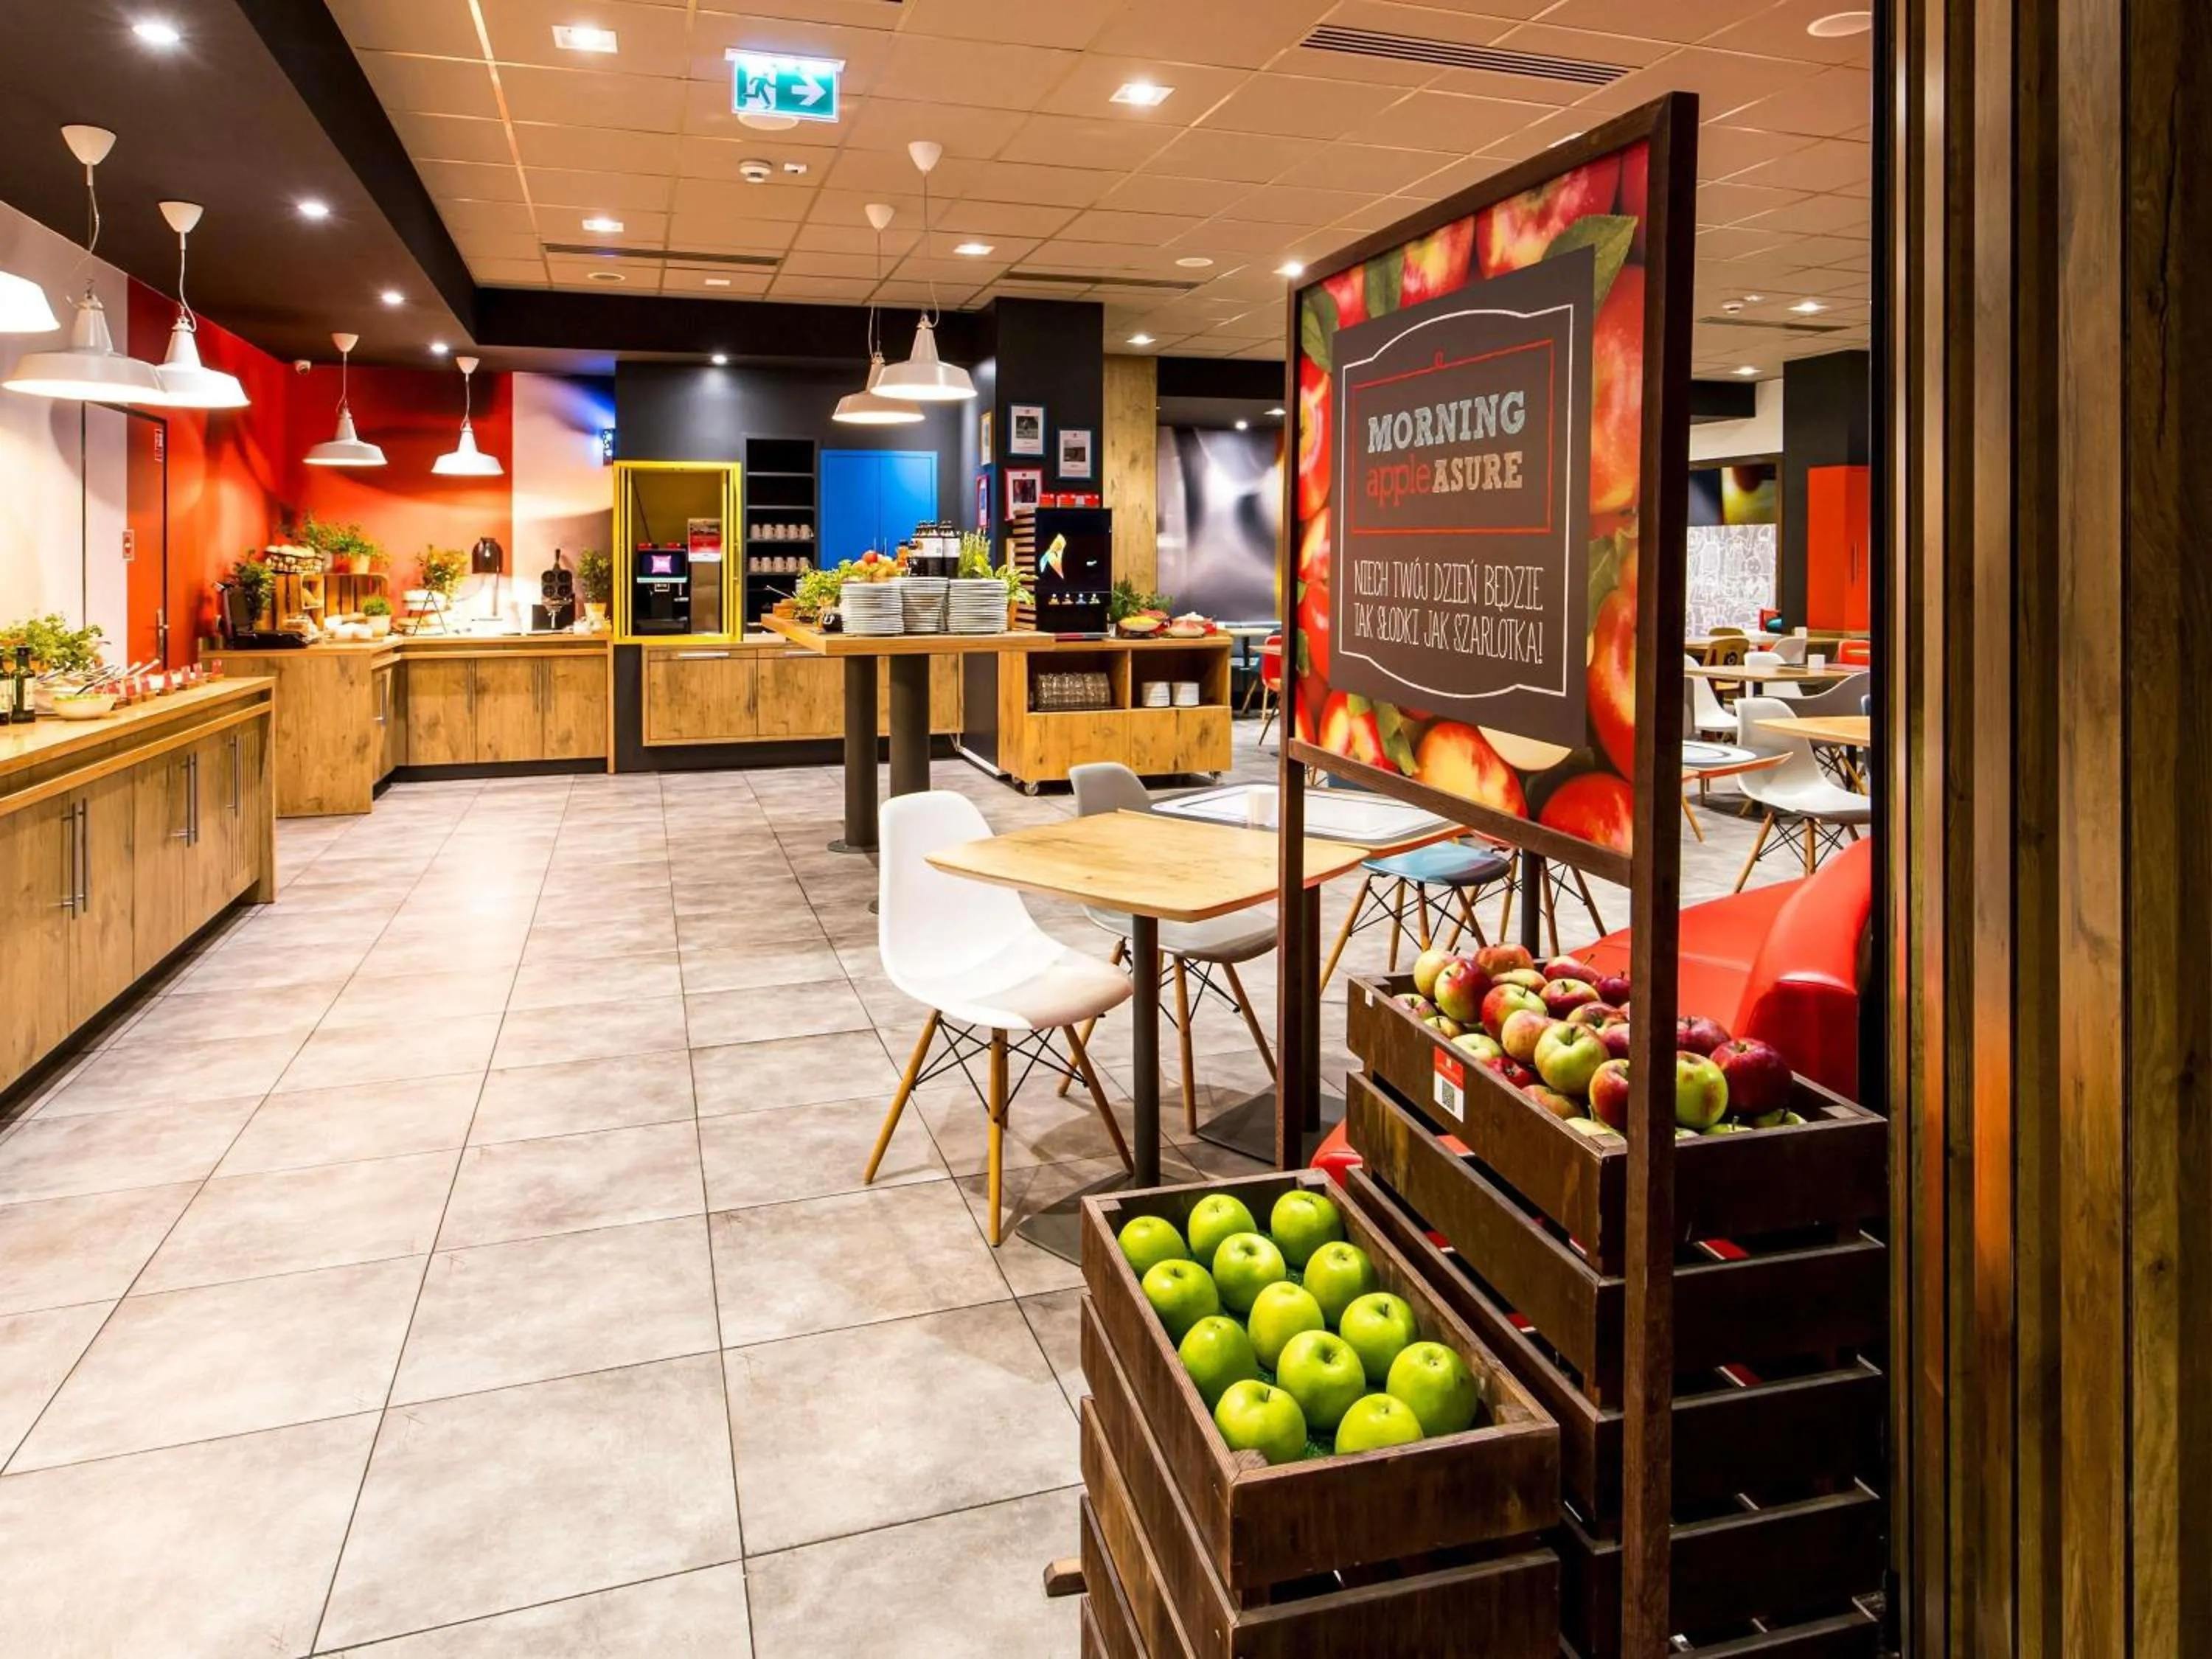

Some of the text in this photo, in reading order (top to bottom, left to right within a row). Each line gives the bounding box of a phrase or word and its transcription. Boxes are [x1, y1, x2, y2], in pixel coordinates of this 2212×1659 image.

[1368, 390, 1526, 453] MORNING
[1354, 557, 1545, 611] NIECH TWÓJ DZIEŃ BĘDZIE
[1354, 602, 1544, 664] TAK SŁODKI JAK SZARLOTKA!
